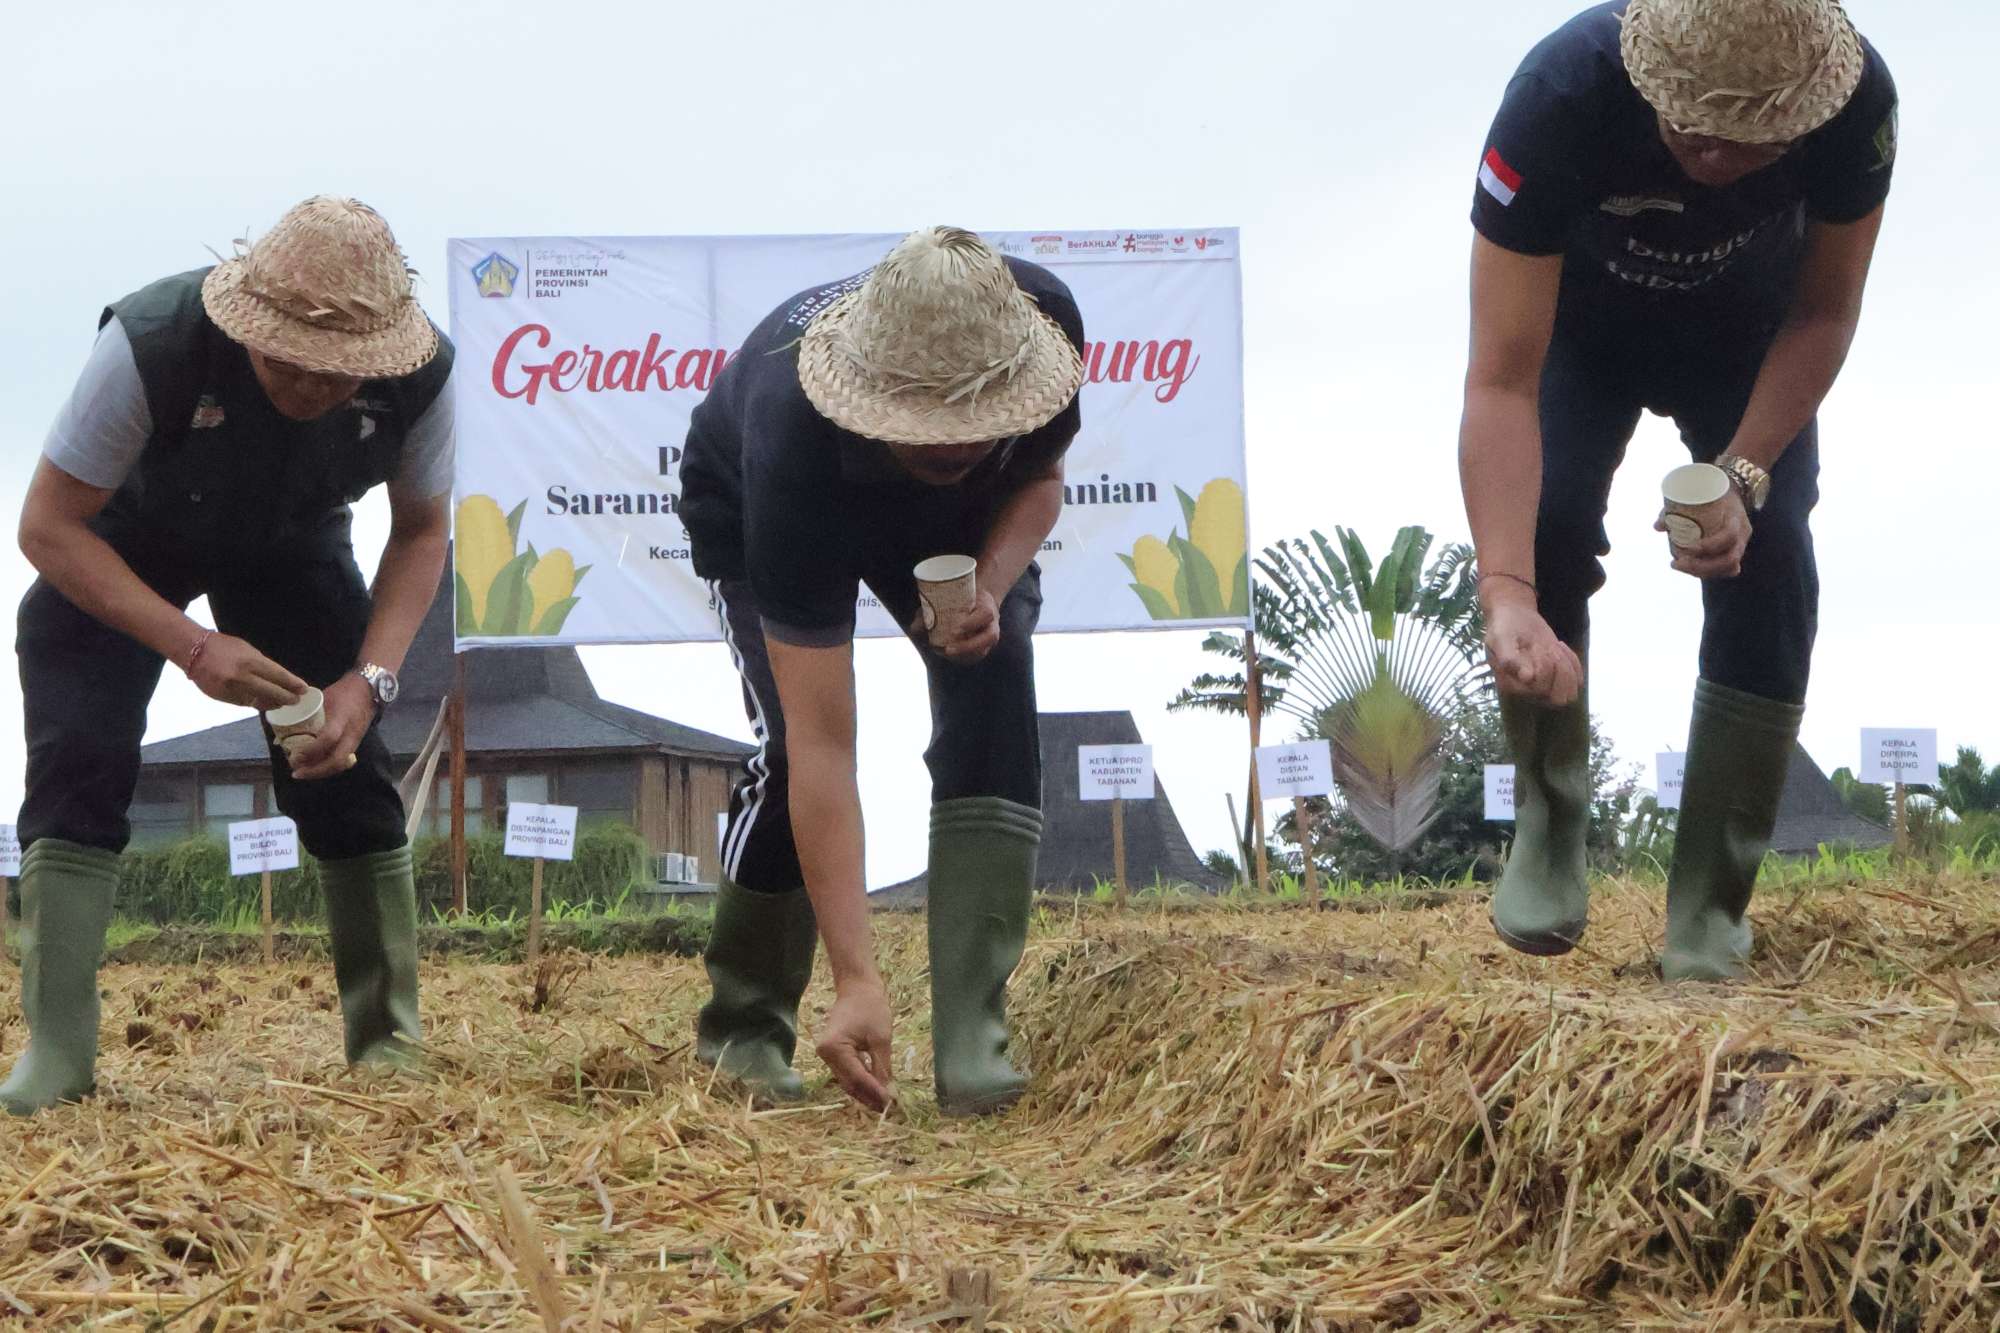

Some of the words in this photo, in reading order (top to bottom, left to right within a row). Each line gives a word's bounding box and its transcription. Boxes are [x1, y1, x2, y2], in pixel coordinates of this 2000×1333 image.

[1067, 240, 1118, 249] BerAKHLAK
[535, 269, 608, 277] PEMERINTAH
[535, 279, 589, 287] PROVINSI
[535, 290, 561, 298] BALI
[546, 485, 680, 515] Sarana
[648, 546, 692, 560] Keca
[1881, 740, 1916, 748] KEPALA
[1088, 757, 1118, 765] KETUA
[1277, 754, 1309, 763] KEPALA
[1280, 765, 1309, 774] DISTAN
[1880, 761, 1919, 769] BADUNG
[1091, 767, 1142, 775] KABUPATEN
[1097, 777, 1137, 785] TABANAN
[1276, 775, 1314, 784] TABANAN
[526, 815, 556, 824] KEPALA
[233, 831, 264, 841] KEPALA
[265, 827, 293, 837] PERUM
[511, 824, 571, 836] DISTANPANGAN
[511, 834, 547, 844] PROVINSI
[548, 838, 568, 846] BALI
[236, 850, 273, 860] PROVINSI
[274, 848, 292, 856] BALI
